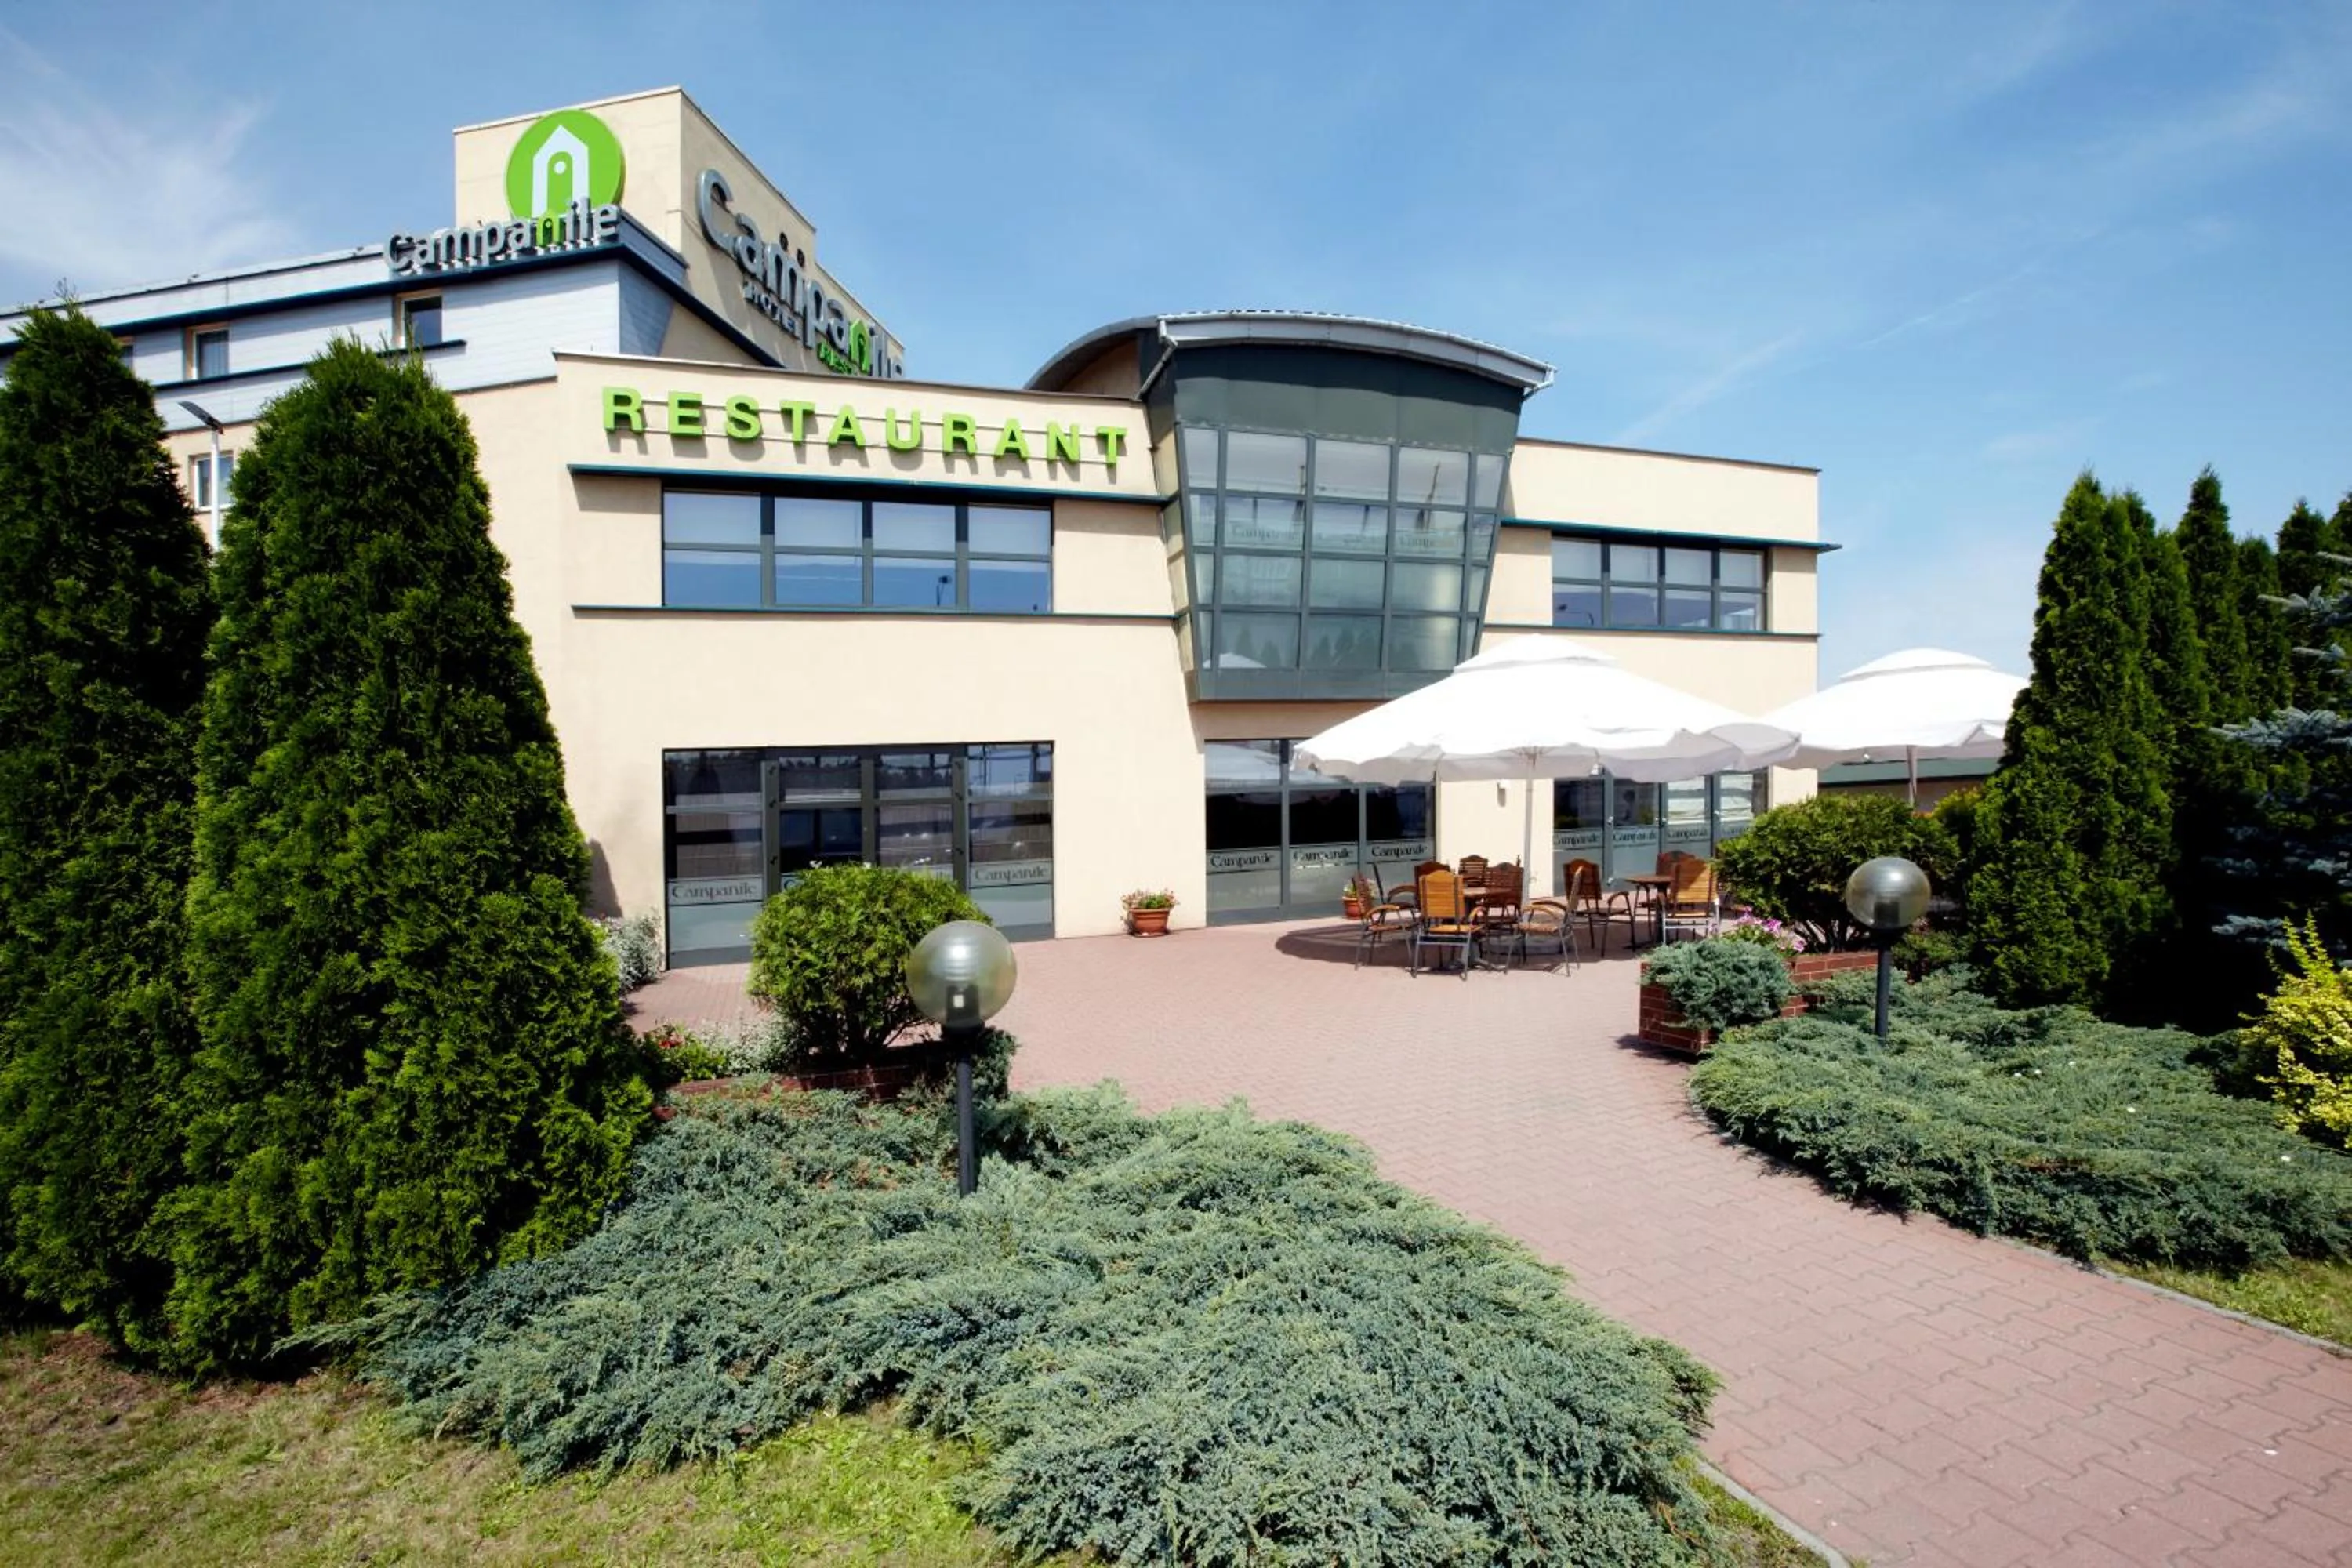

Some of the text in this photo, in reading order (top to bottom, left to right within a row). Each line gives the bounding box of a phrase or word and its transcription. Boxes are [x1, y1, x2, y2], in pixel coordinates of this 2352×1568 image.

[383, 196, 620, 270] Campanile
[697, 169, 904, 379] Campanile
[603, 387, 1127, 464] RESTAURANT
[1210, 851, 1273, 869] Campanile
[1372, 843, 1428, 859] Campanile
[975, 864, 1048, 881] Campanile
[672, 881, 757, 901] Campanile
